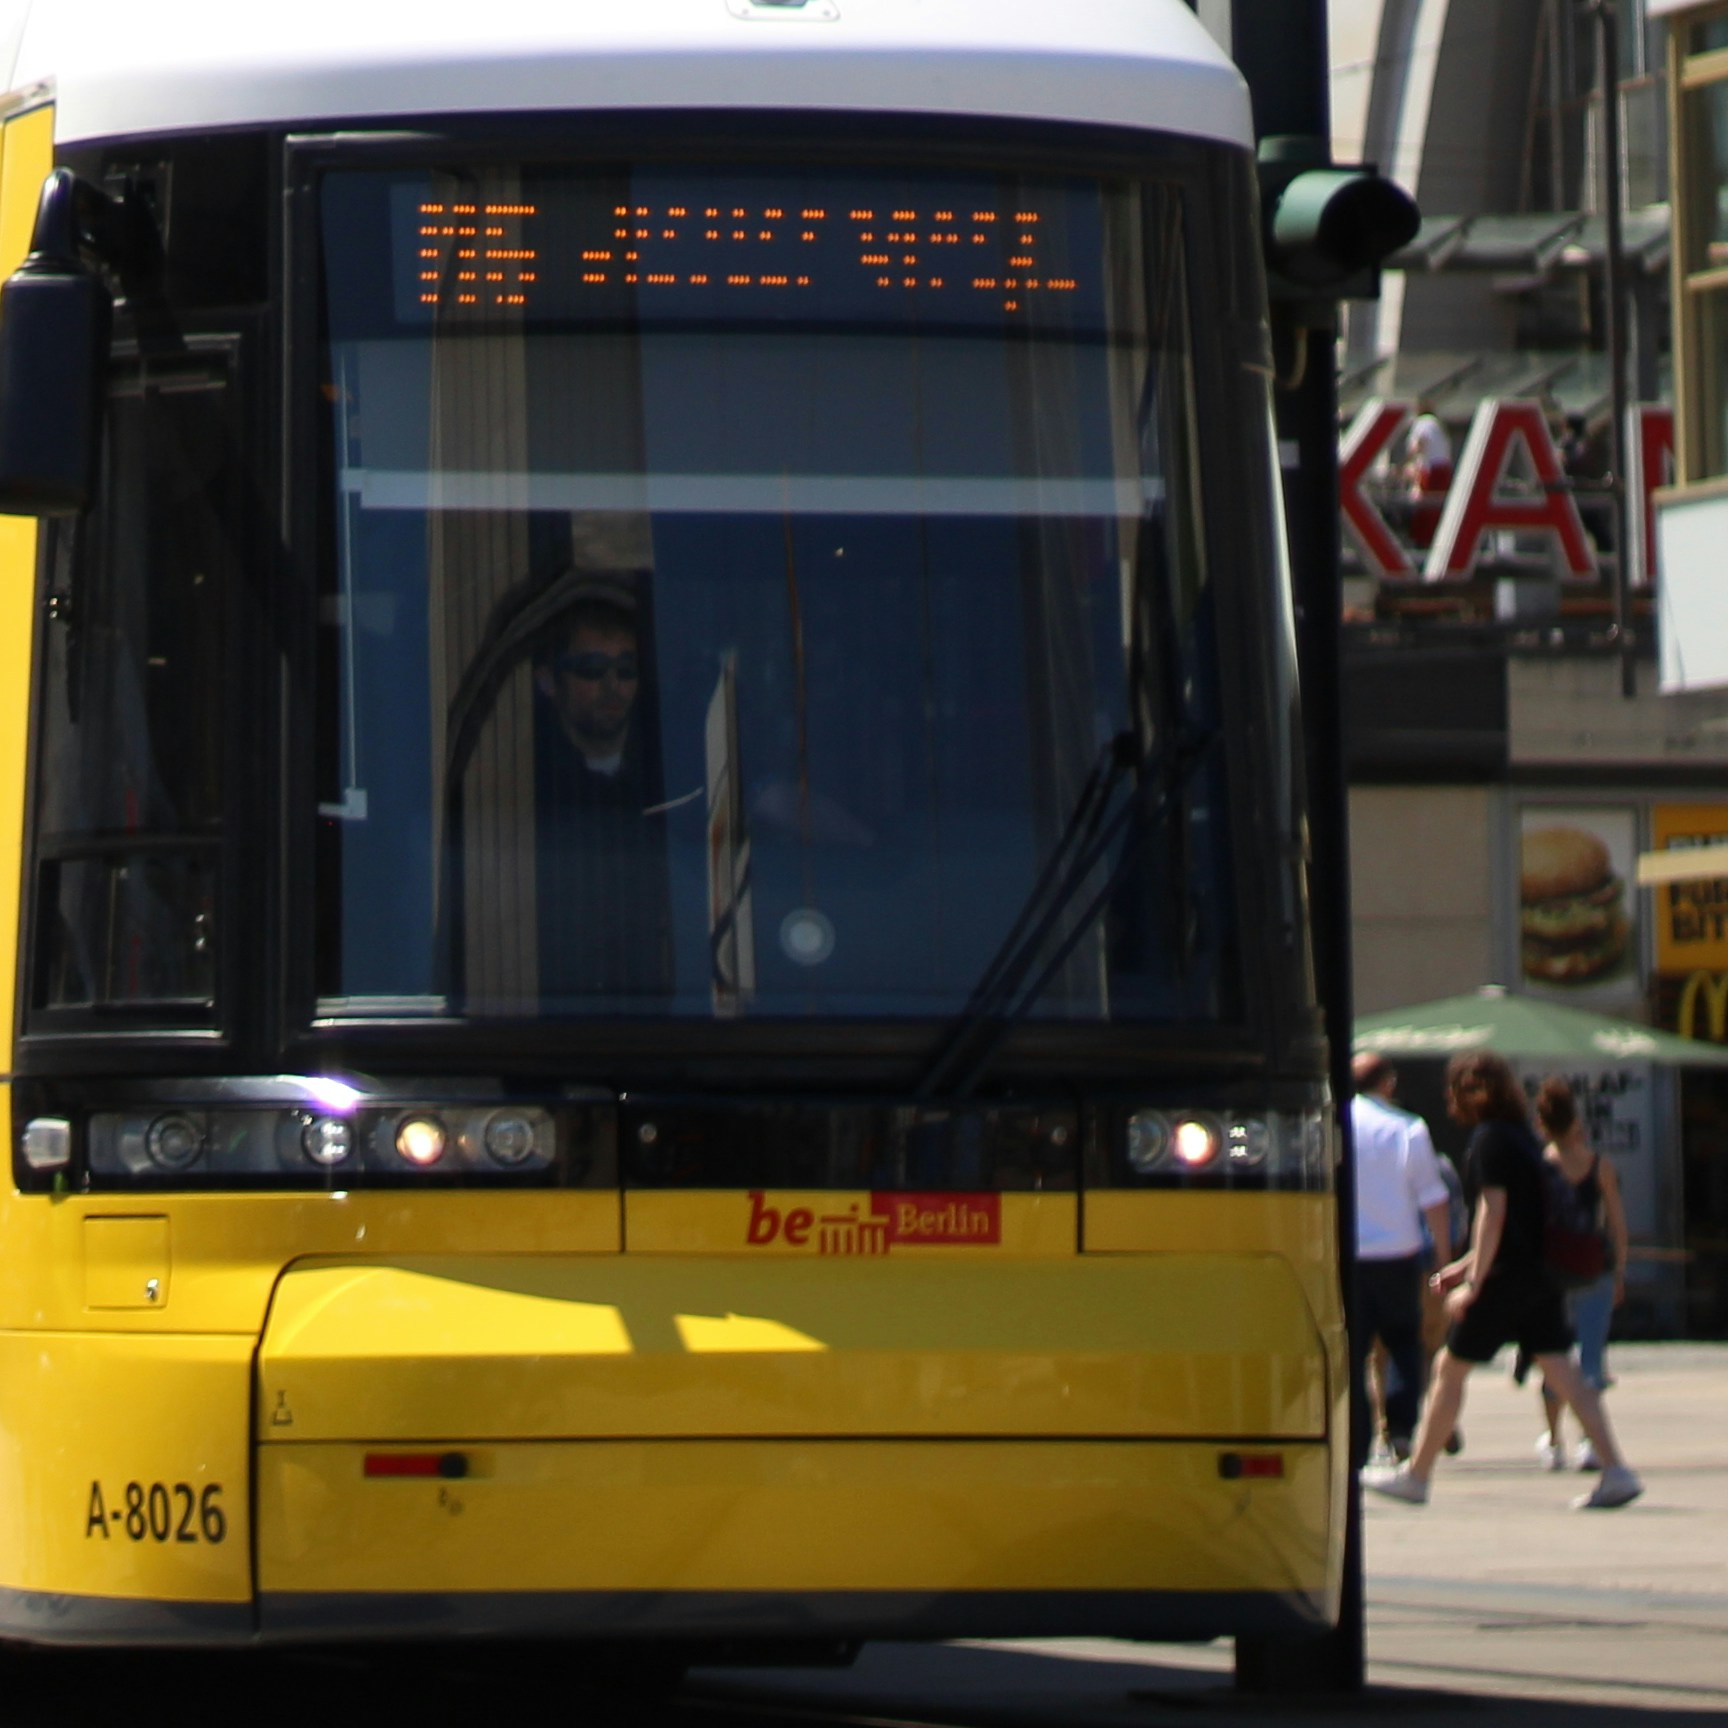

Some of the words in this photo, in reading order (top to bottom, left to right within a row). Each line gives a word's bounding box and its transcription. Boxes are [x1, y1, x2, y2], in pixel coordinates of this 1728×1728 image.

[748, 1191, 814, 1244] be
[897, 1201, 990, 1236] Berlin
[86, 1480, 227, 1544] A-8026
